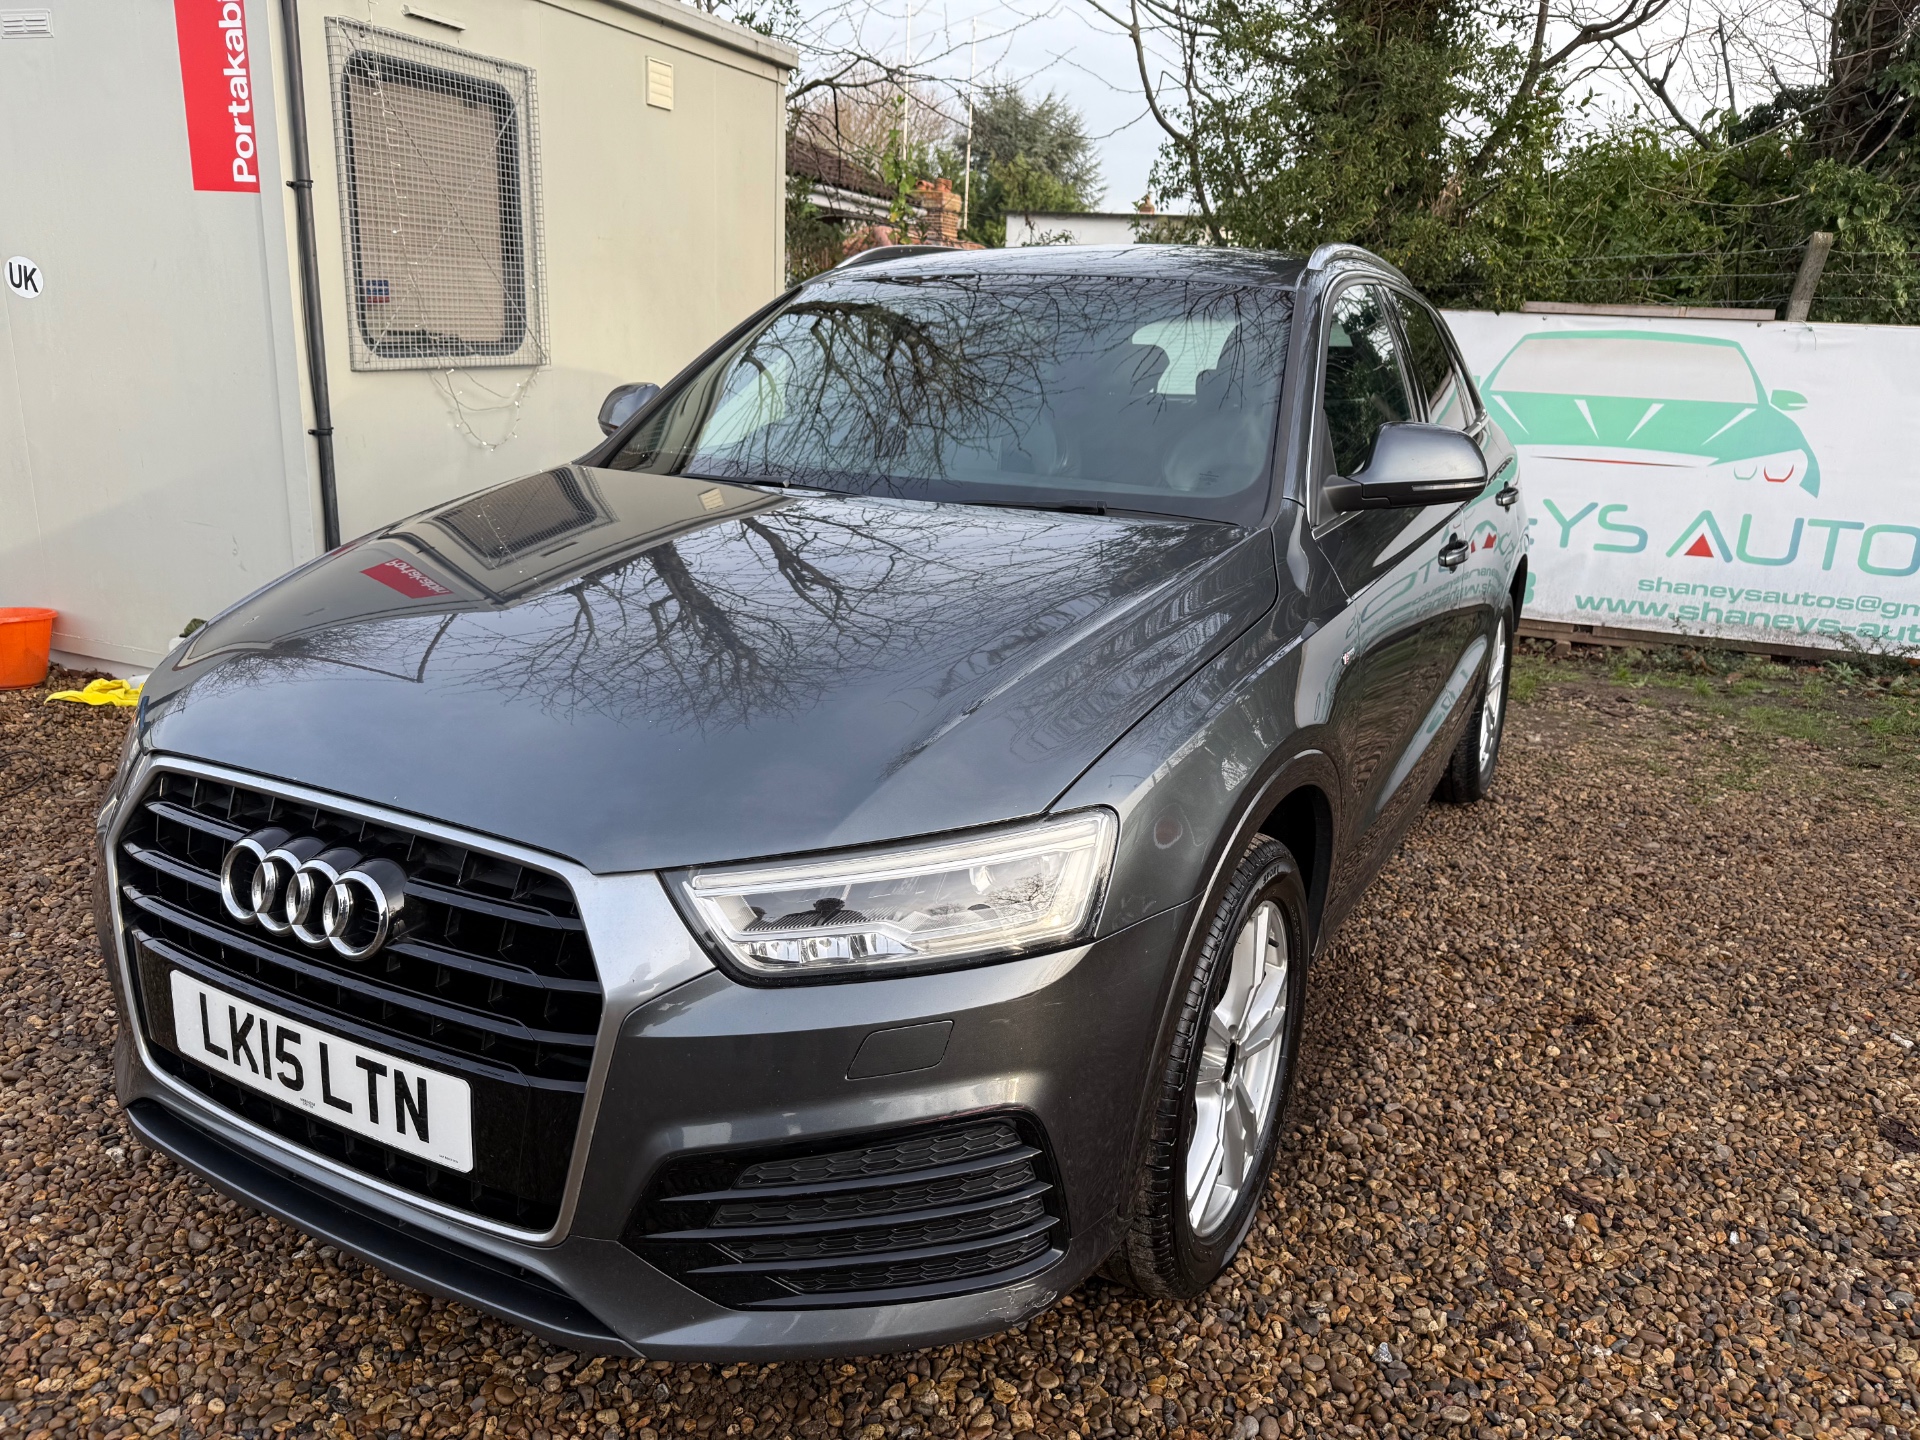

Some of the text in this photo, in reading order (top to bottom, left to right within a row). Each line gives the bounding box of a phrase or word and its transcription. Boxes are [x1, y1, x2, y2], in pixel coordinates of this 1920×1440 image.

[218, 0, 256, 183] Portakab
[8, 261, 39, 293] UK
[1665, 509, 1920, 577] AUTO
[199, 991, 430, 1144] LK15 LTN
